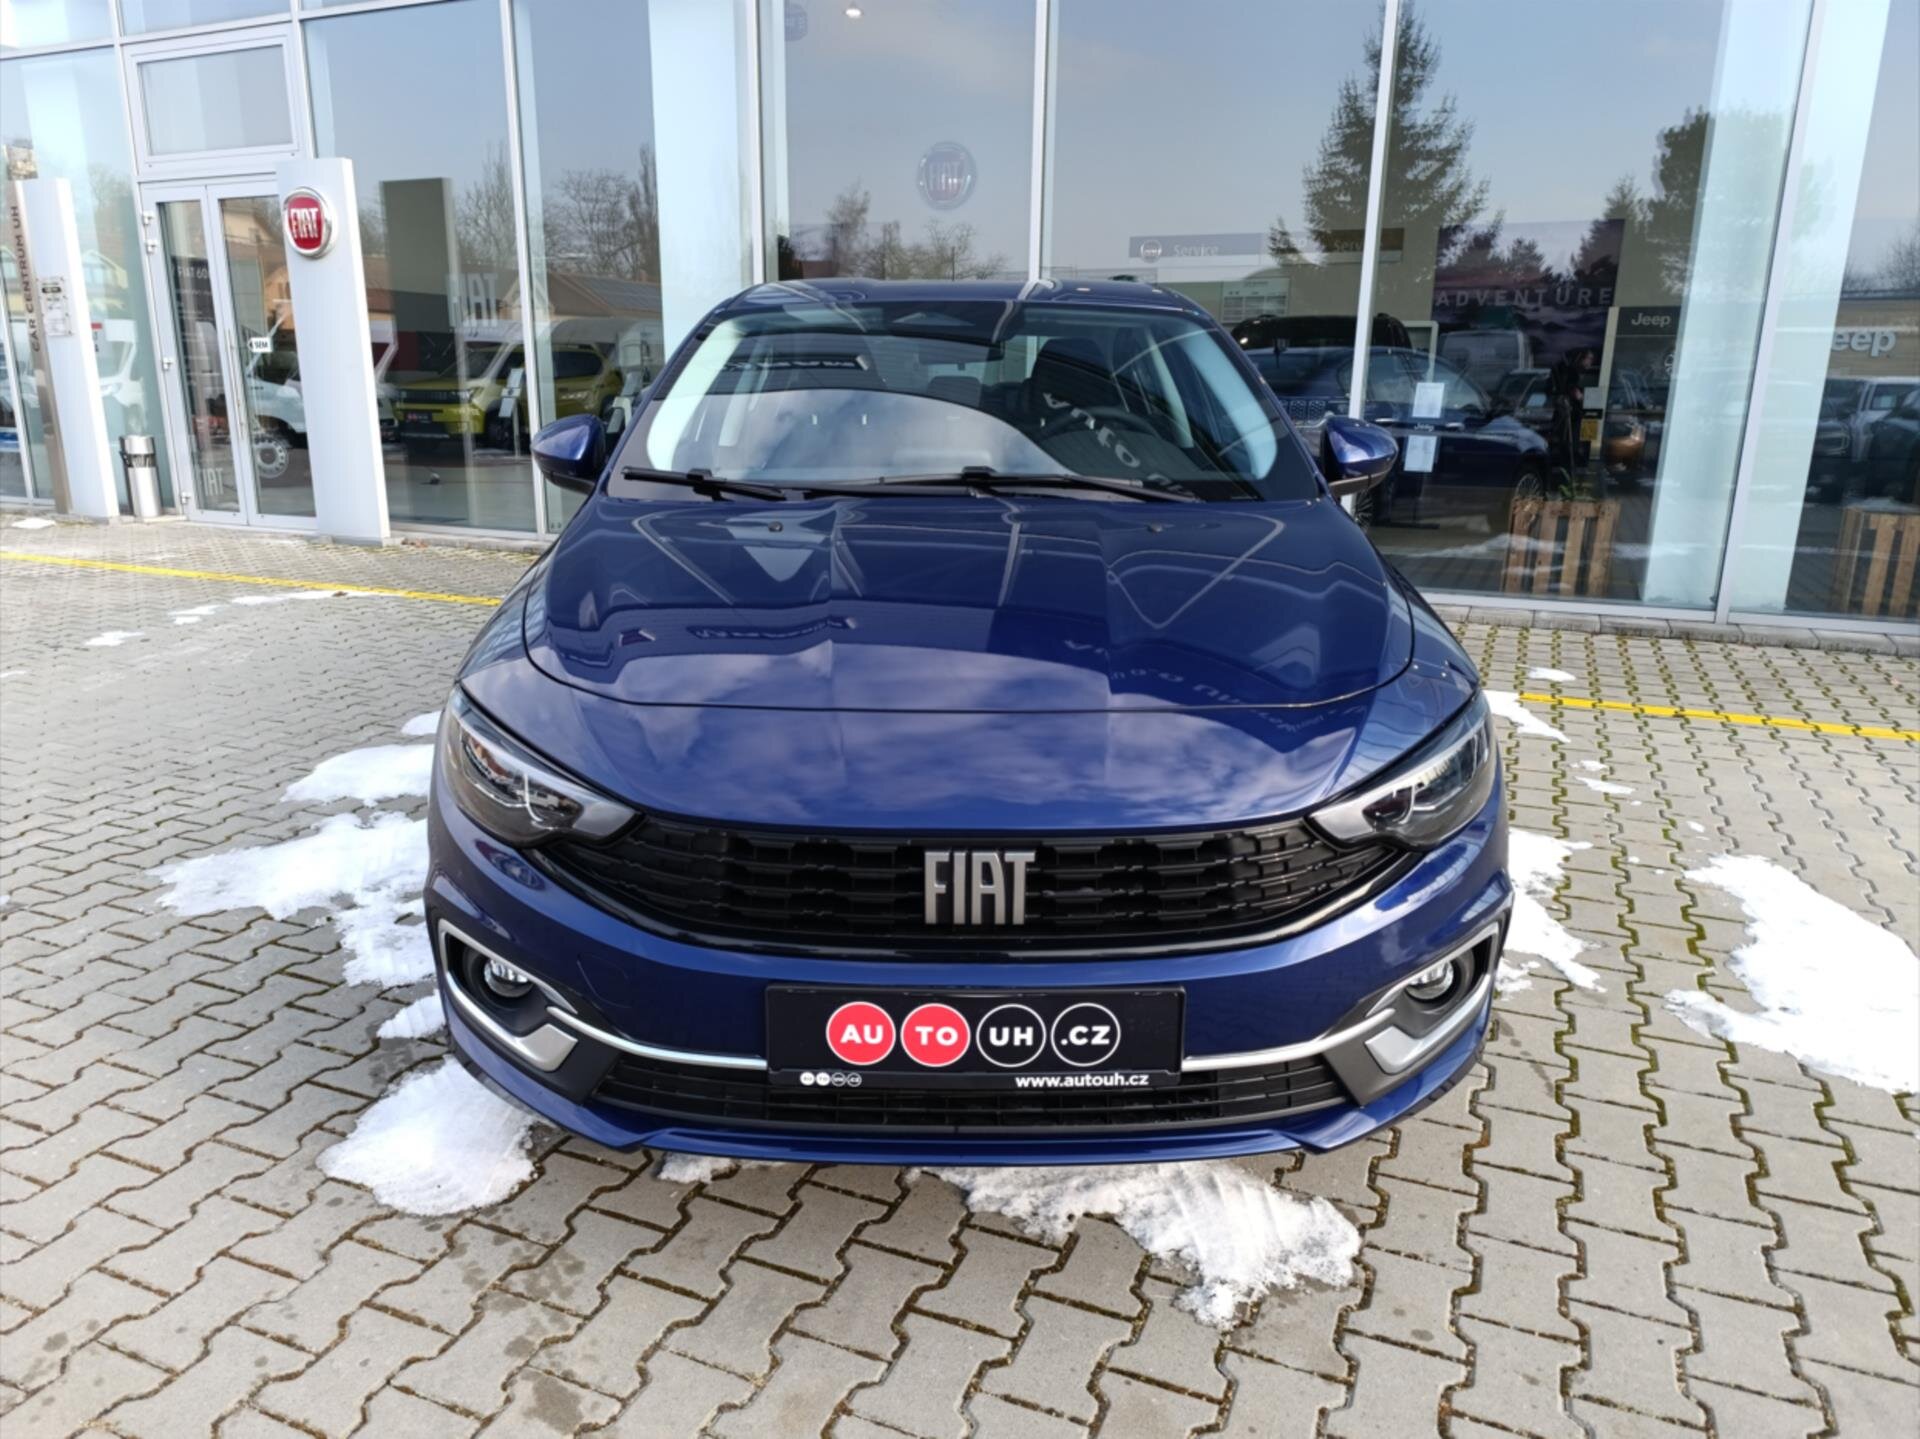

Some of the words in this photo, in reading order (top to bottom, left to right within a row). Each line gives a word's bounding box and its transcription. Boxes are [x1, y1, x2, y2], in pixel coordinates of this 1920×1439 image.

[290, 207, 319, 239] FIAT
[14, 235, 35, 313] CENTRUM
[1436, 287, 1613, 307] ADVENTURE
[1631, 312, 1671, 329] Jeep
[1831, 329, 1896, 357] eep
[924, 851, 1036, 925] FIAT
[989, 1027, 1034, 1046] UH
[1015, 1073, 1150, 1088] www.autouh.cz
